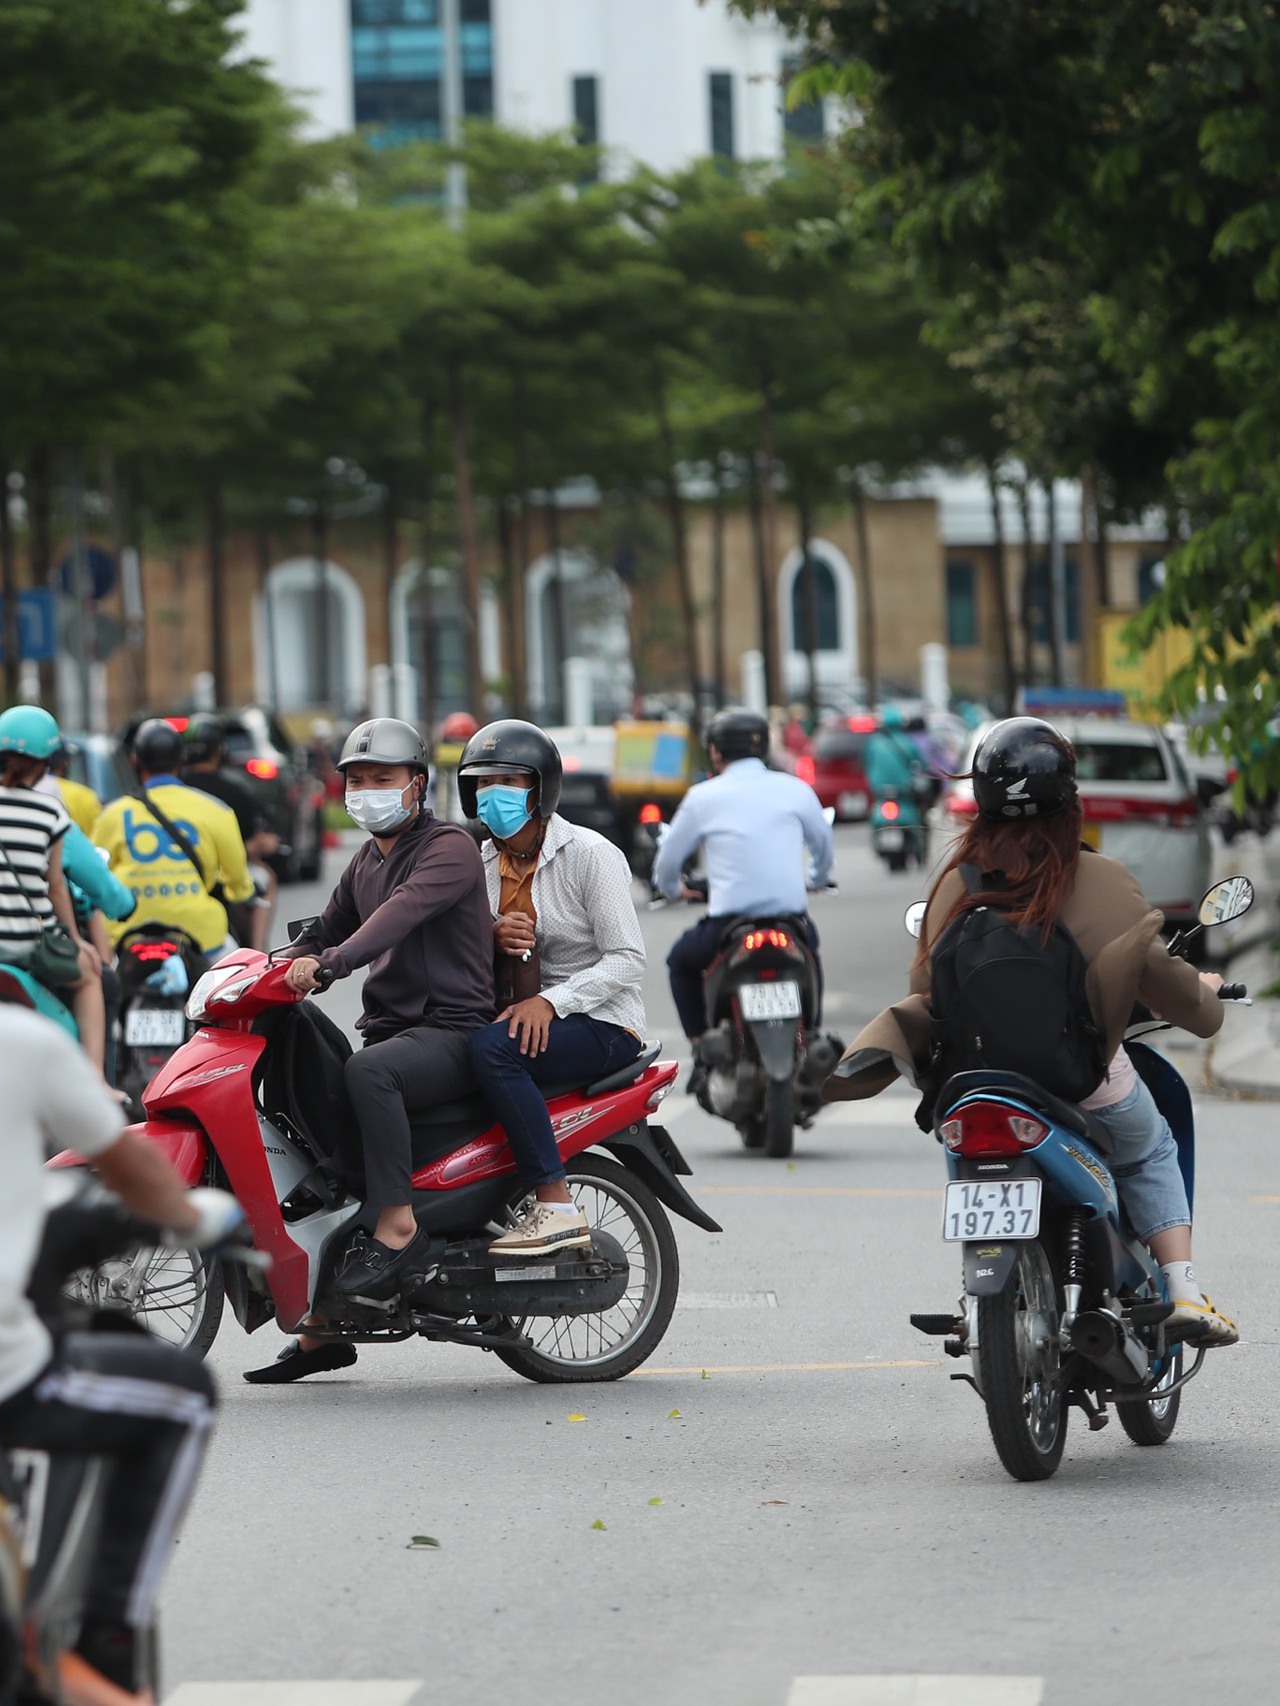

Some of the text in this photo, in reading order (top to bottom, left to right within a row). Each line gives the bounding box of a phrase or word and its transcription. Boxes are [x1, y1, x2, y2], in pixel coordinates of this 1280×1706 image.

[977, 1163, 1010, 1171] HONDA
[960, 1183, 1025, 1210] 14-X1
[951, 1209, 1034, 1237] 197.37
